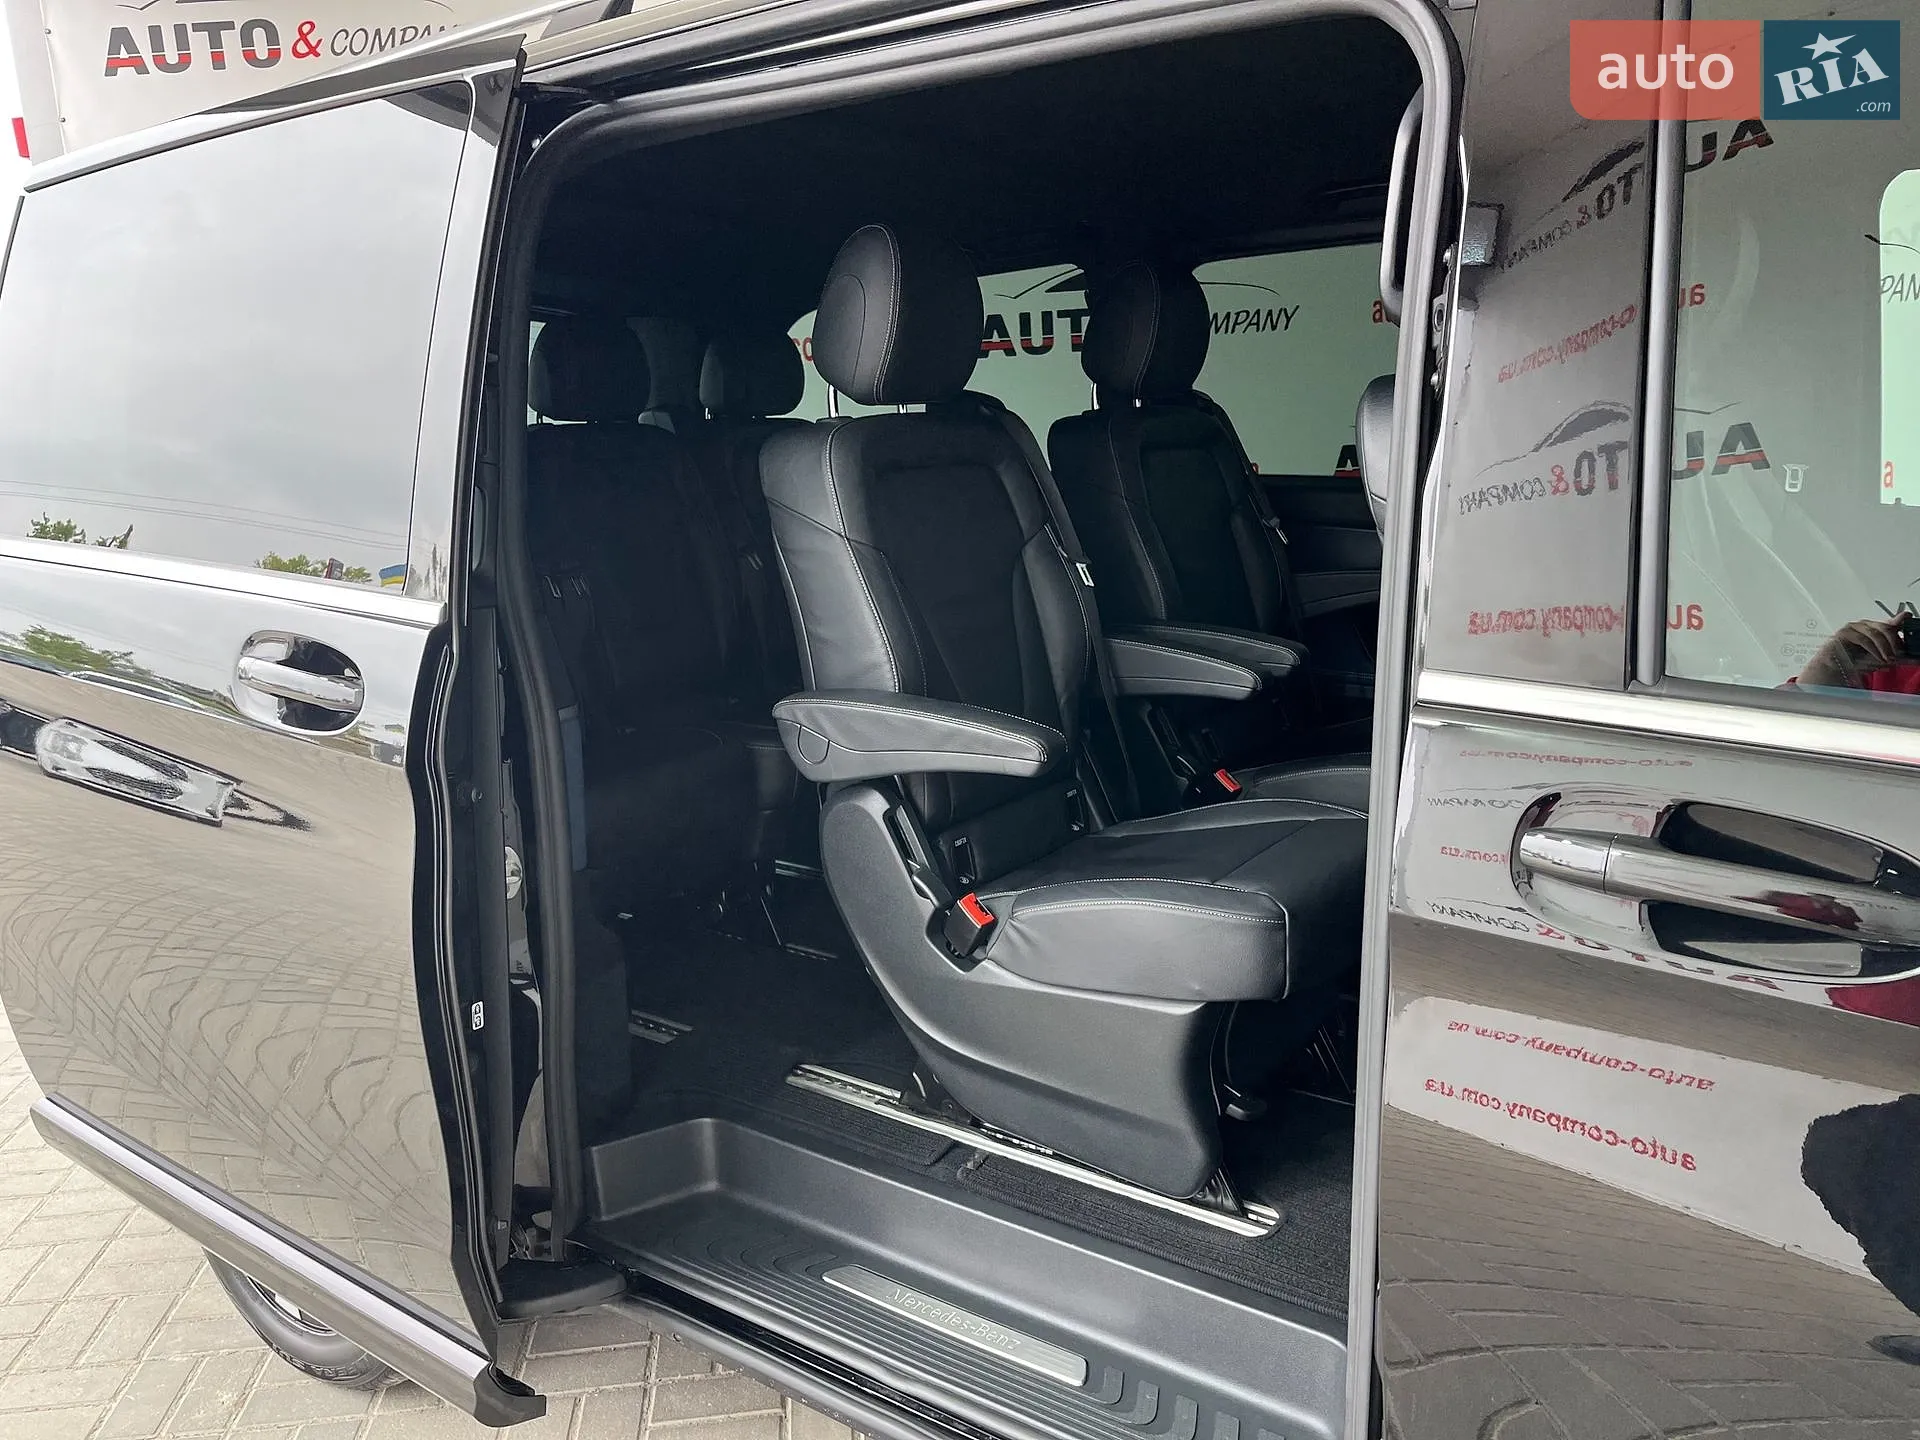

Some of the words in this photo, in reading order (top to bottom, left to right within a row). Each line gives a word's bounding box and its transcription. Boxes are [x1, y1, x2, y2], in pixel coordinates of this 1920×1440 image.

[104, 18, 283, 77] AUTO
[291, 20, 322, 58] &
[330, 22, 462, 56] COMP
[975, 308, 1092, 359] AUT
[1209, 305, 1300, 335] MPANY
[886, 1287, 1022, 1350] Mercedes-Benz
